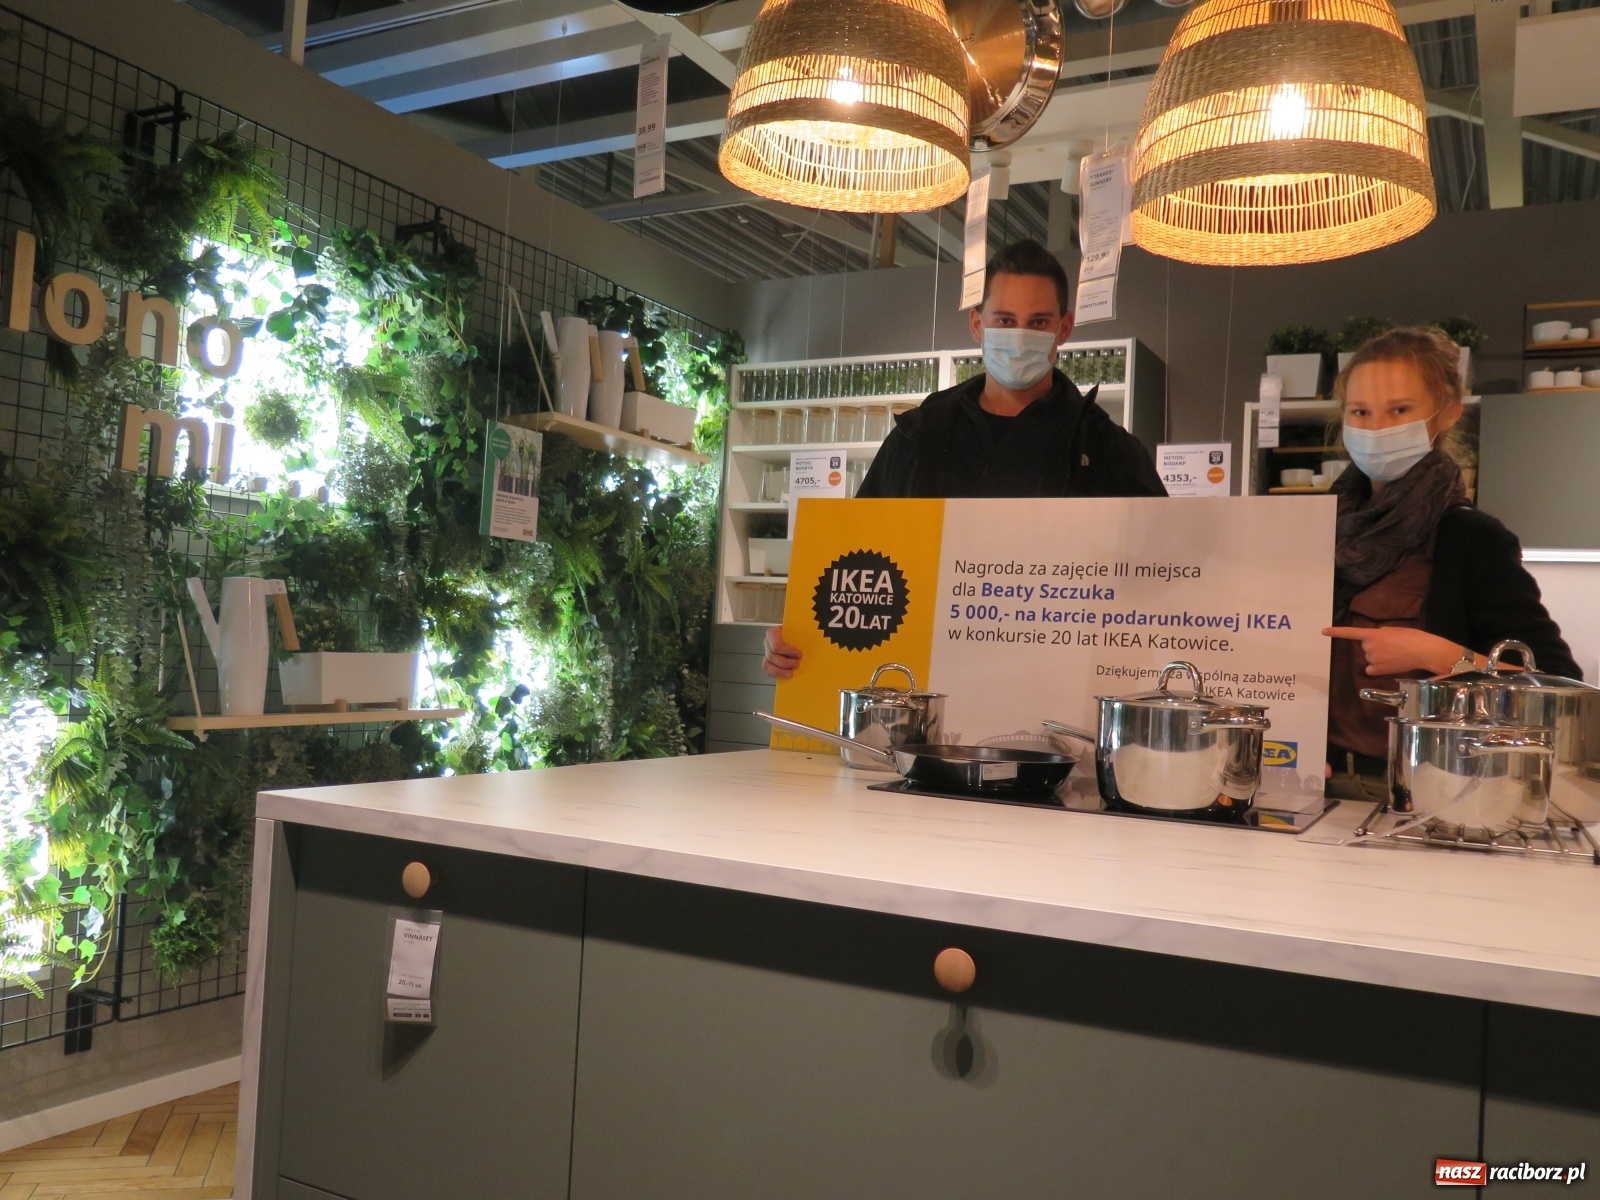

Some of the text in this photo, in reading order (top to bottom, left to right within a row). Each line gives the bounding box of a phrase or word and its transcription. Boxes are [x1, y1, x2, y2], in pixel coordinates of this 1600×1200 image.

[831, 569, 894, 593] IKEA
[954, 560, 1201, 582] Nagroda za zajęcie III miejsca
[830, 592, 894, 606] KATOWICE
[952, 582, 1115, 602] dla Beaty Szczuka
[1015, 609, 1036, 622] na
[1041, 607, 1097, 624] karcie
[1102, 610, 1240, 633] podarunkowej
[1247, 614, 1292, 630] IKEA
[948, 626, 1234, 652] w konkursie 20 lat IKEA Katowice.
[1096, 664, 1162, 681] Dziękujem
[1243, 672, 1296, 687] zabawę!
[1205, 686, 1296, 701] IKEA Katowice
